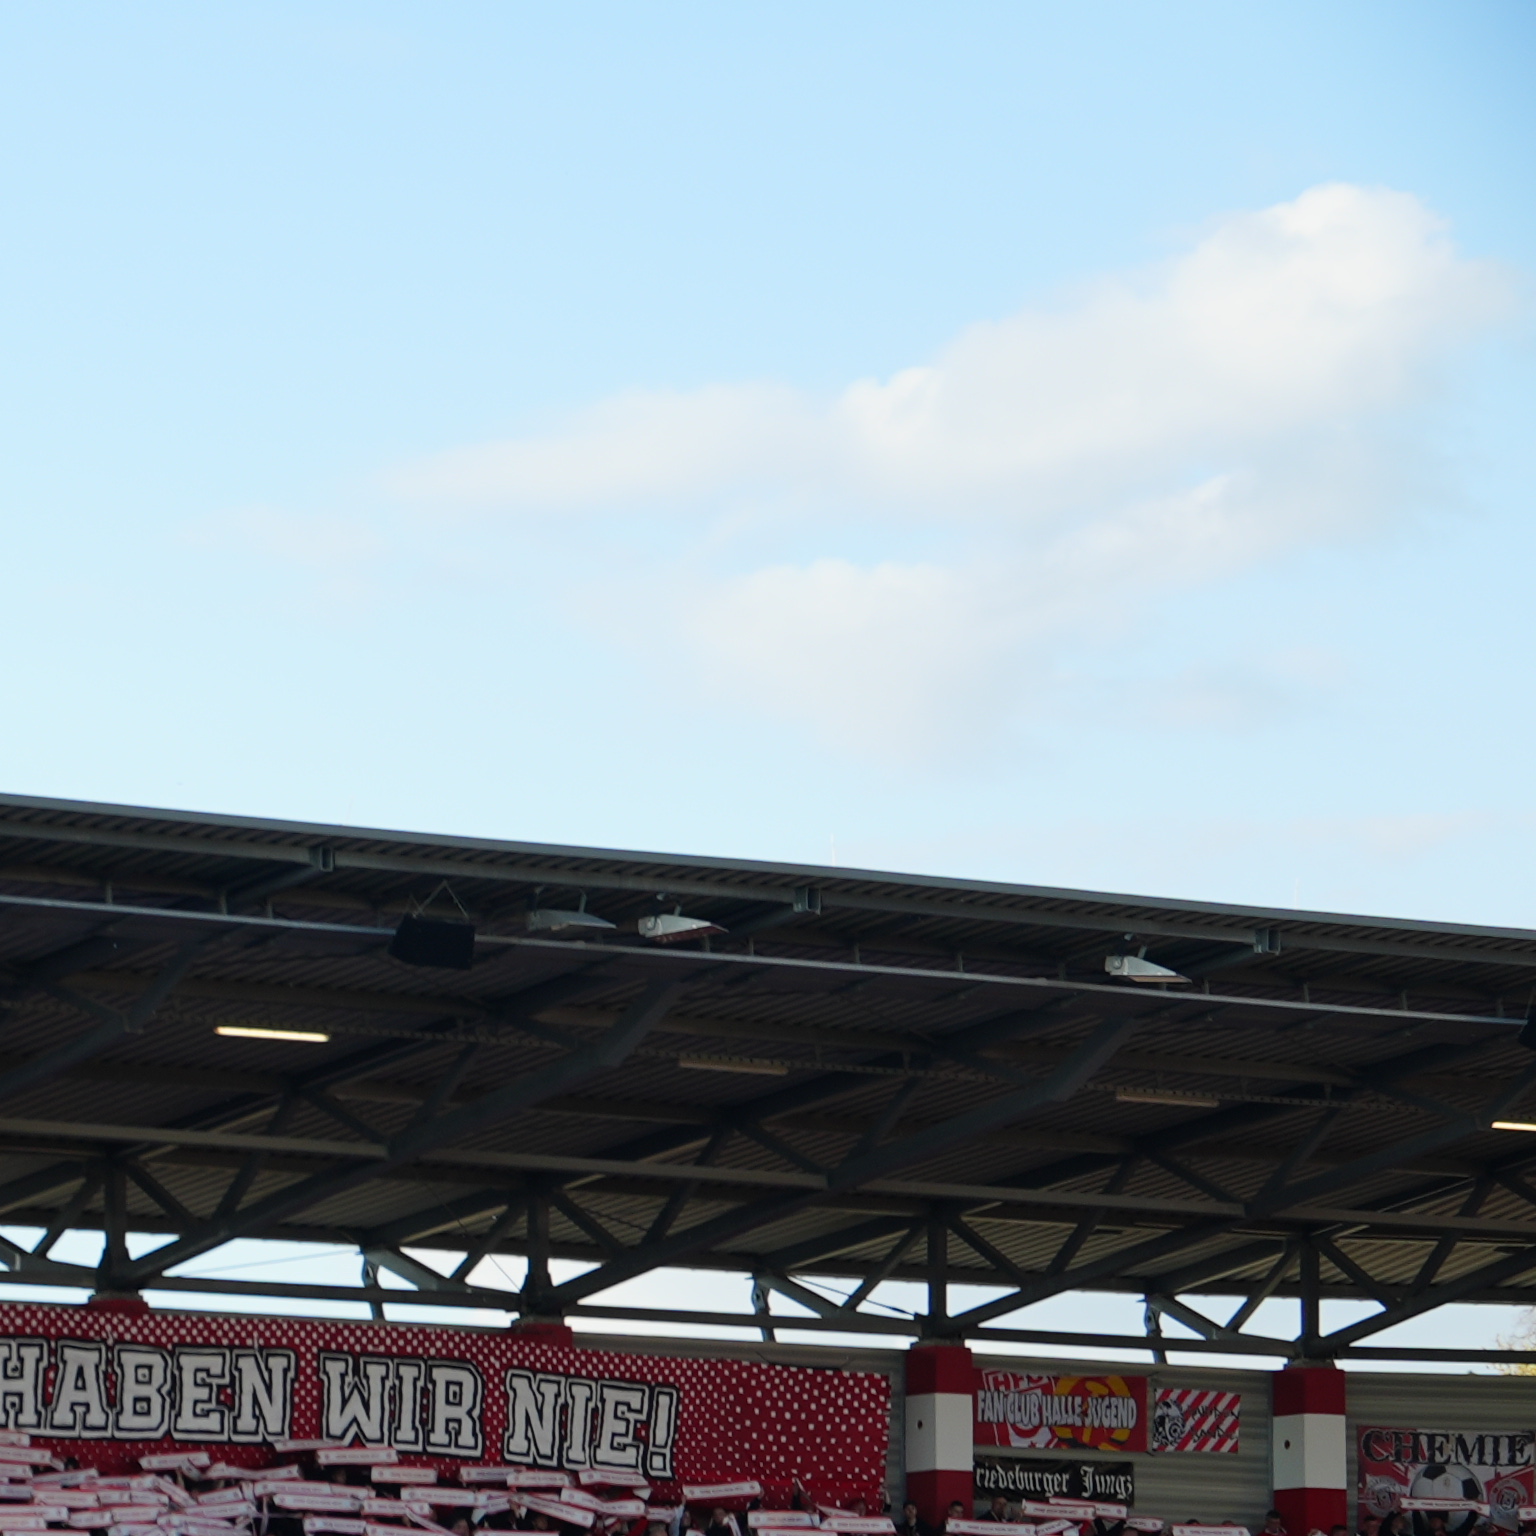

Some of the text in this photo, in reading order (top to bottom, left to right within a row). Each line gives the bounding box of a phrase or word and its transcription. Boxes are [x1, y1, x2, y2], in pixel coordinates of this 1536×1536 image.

[318, 1352, 484, 1458] WIR
[504, 1368, 679, 1478] NIE!
[1042, 1395, 1083, 1428] HALLE
[1084, 1396, 1138, 1429] JUGEND
[1362, 1430, 1533, 1467] CHEMIE
[975, 1463, 1070, 1497] riedeburger
